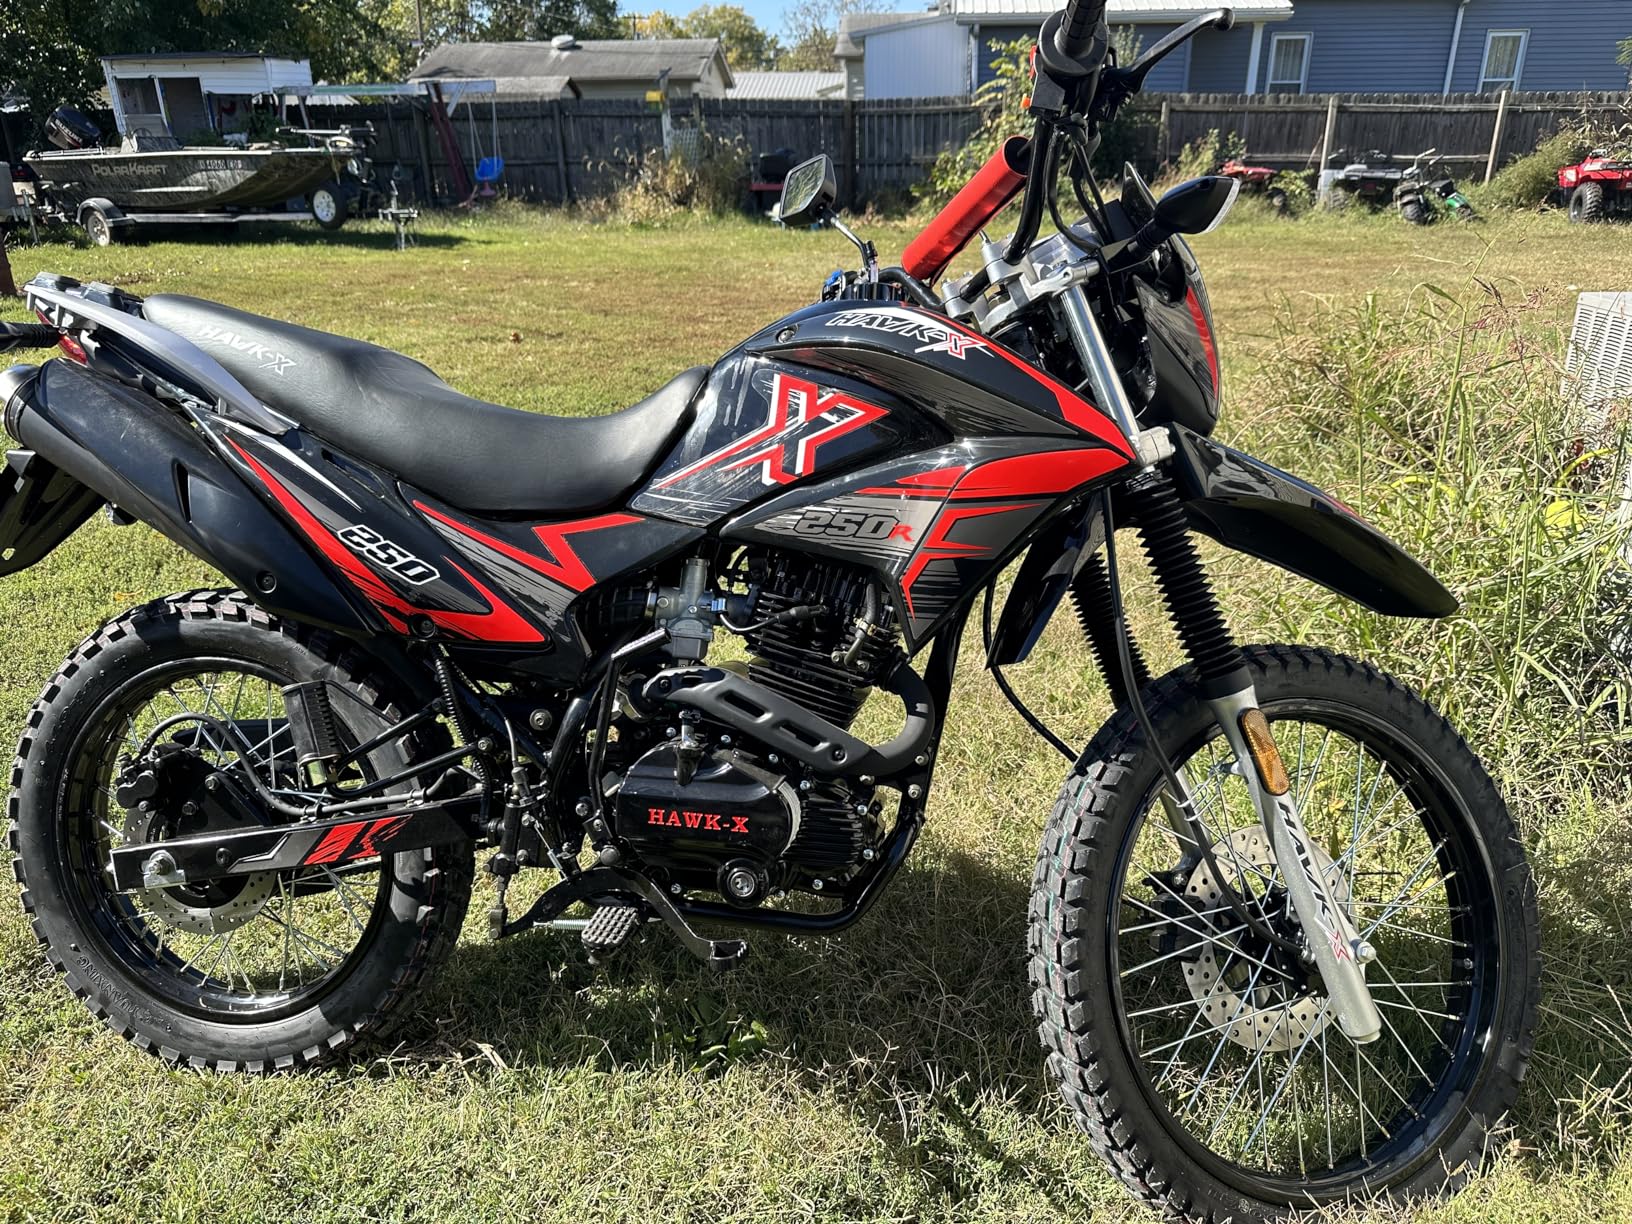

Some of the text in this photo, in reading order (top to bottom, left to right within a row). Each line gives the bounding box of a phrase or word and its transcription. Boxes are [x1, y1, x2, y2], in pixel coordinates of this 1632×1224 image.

[55, 119, 83, 143] SUZUKI
[197, 325, 297, 376] HAWK-X
[825, 312, 988, 360] HAWK-X
[337, 524, 441, 585] 250
[647, 808, 749, 833] HAWK-X
[1277, 801, 1350, 964] HAWK-X
